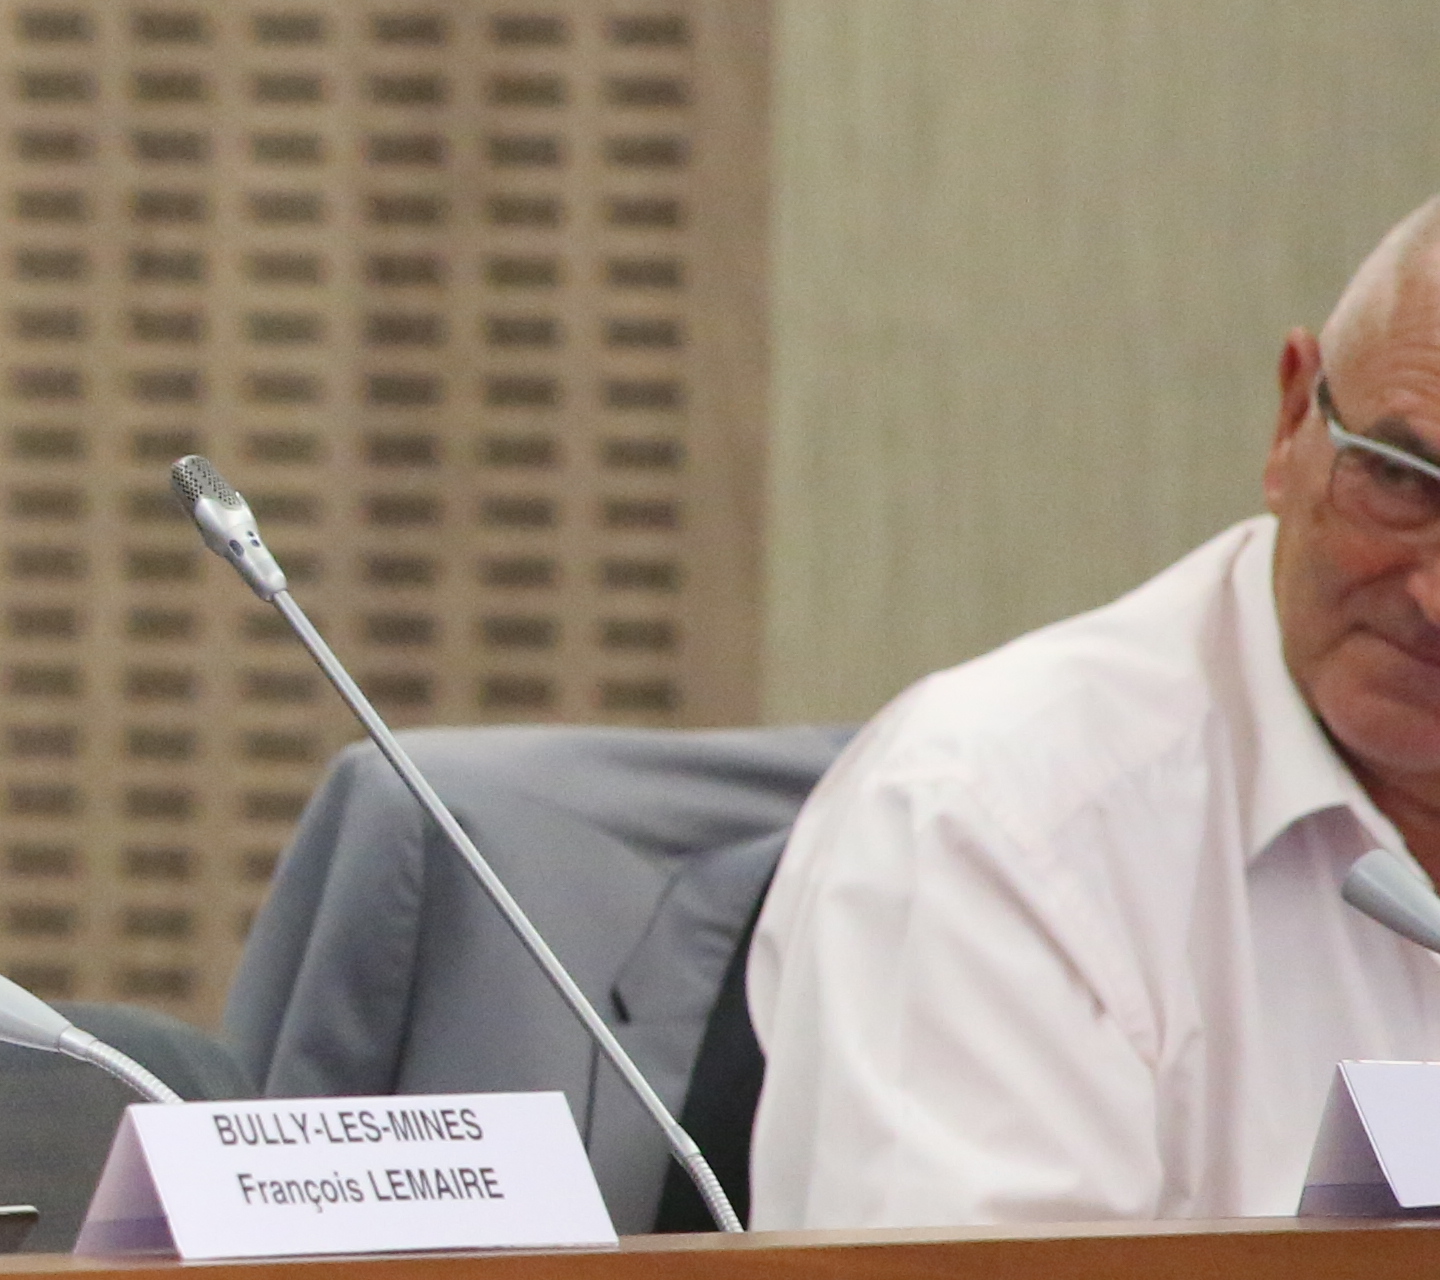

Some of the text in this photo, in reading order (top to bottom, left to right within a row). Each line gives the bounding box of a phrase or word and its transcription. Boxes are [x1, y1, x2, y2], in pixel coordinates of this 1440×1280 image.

[212, 1107, 484, 1146] BULLY-LES-MINES
[237, 1166, 505, 1213] François LEMAIRE
